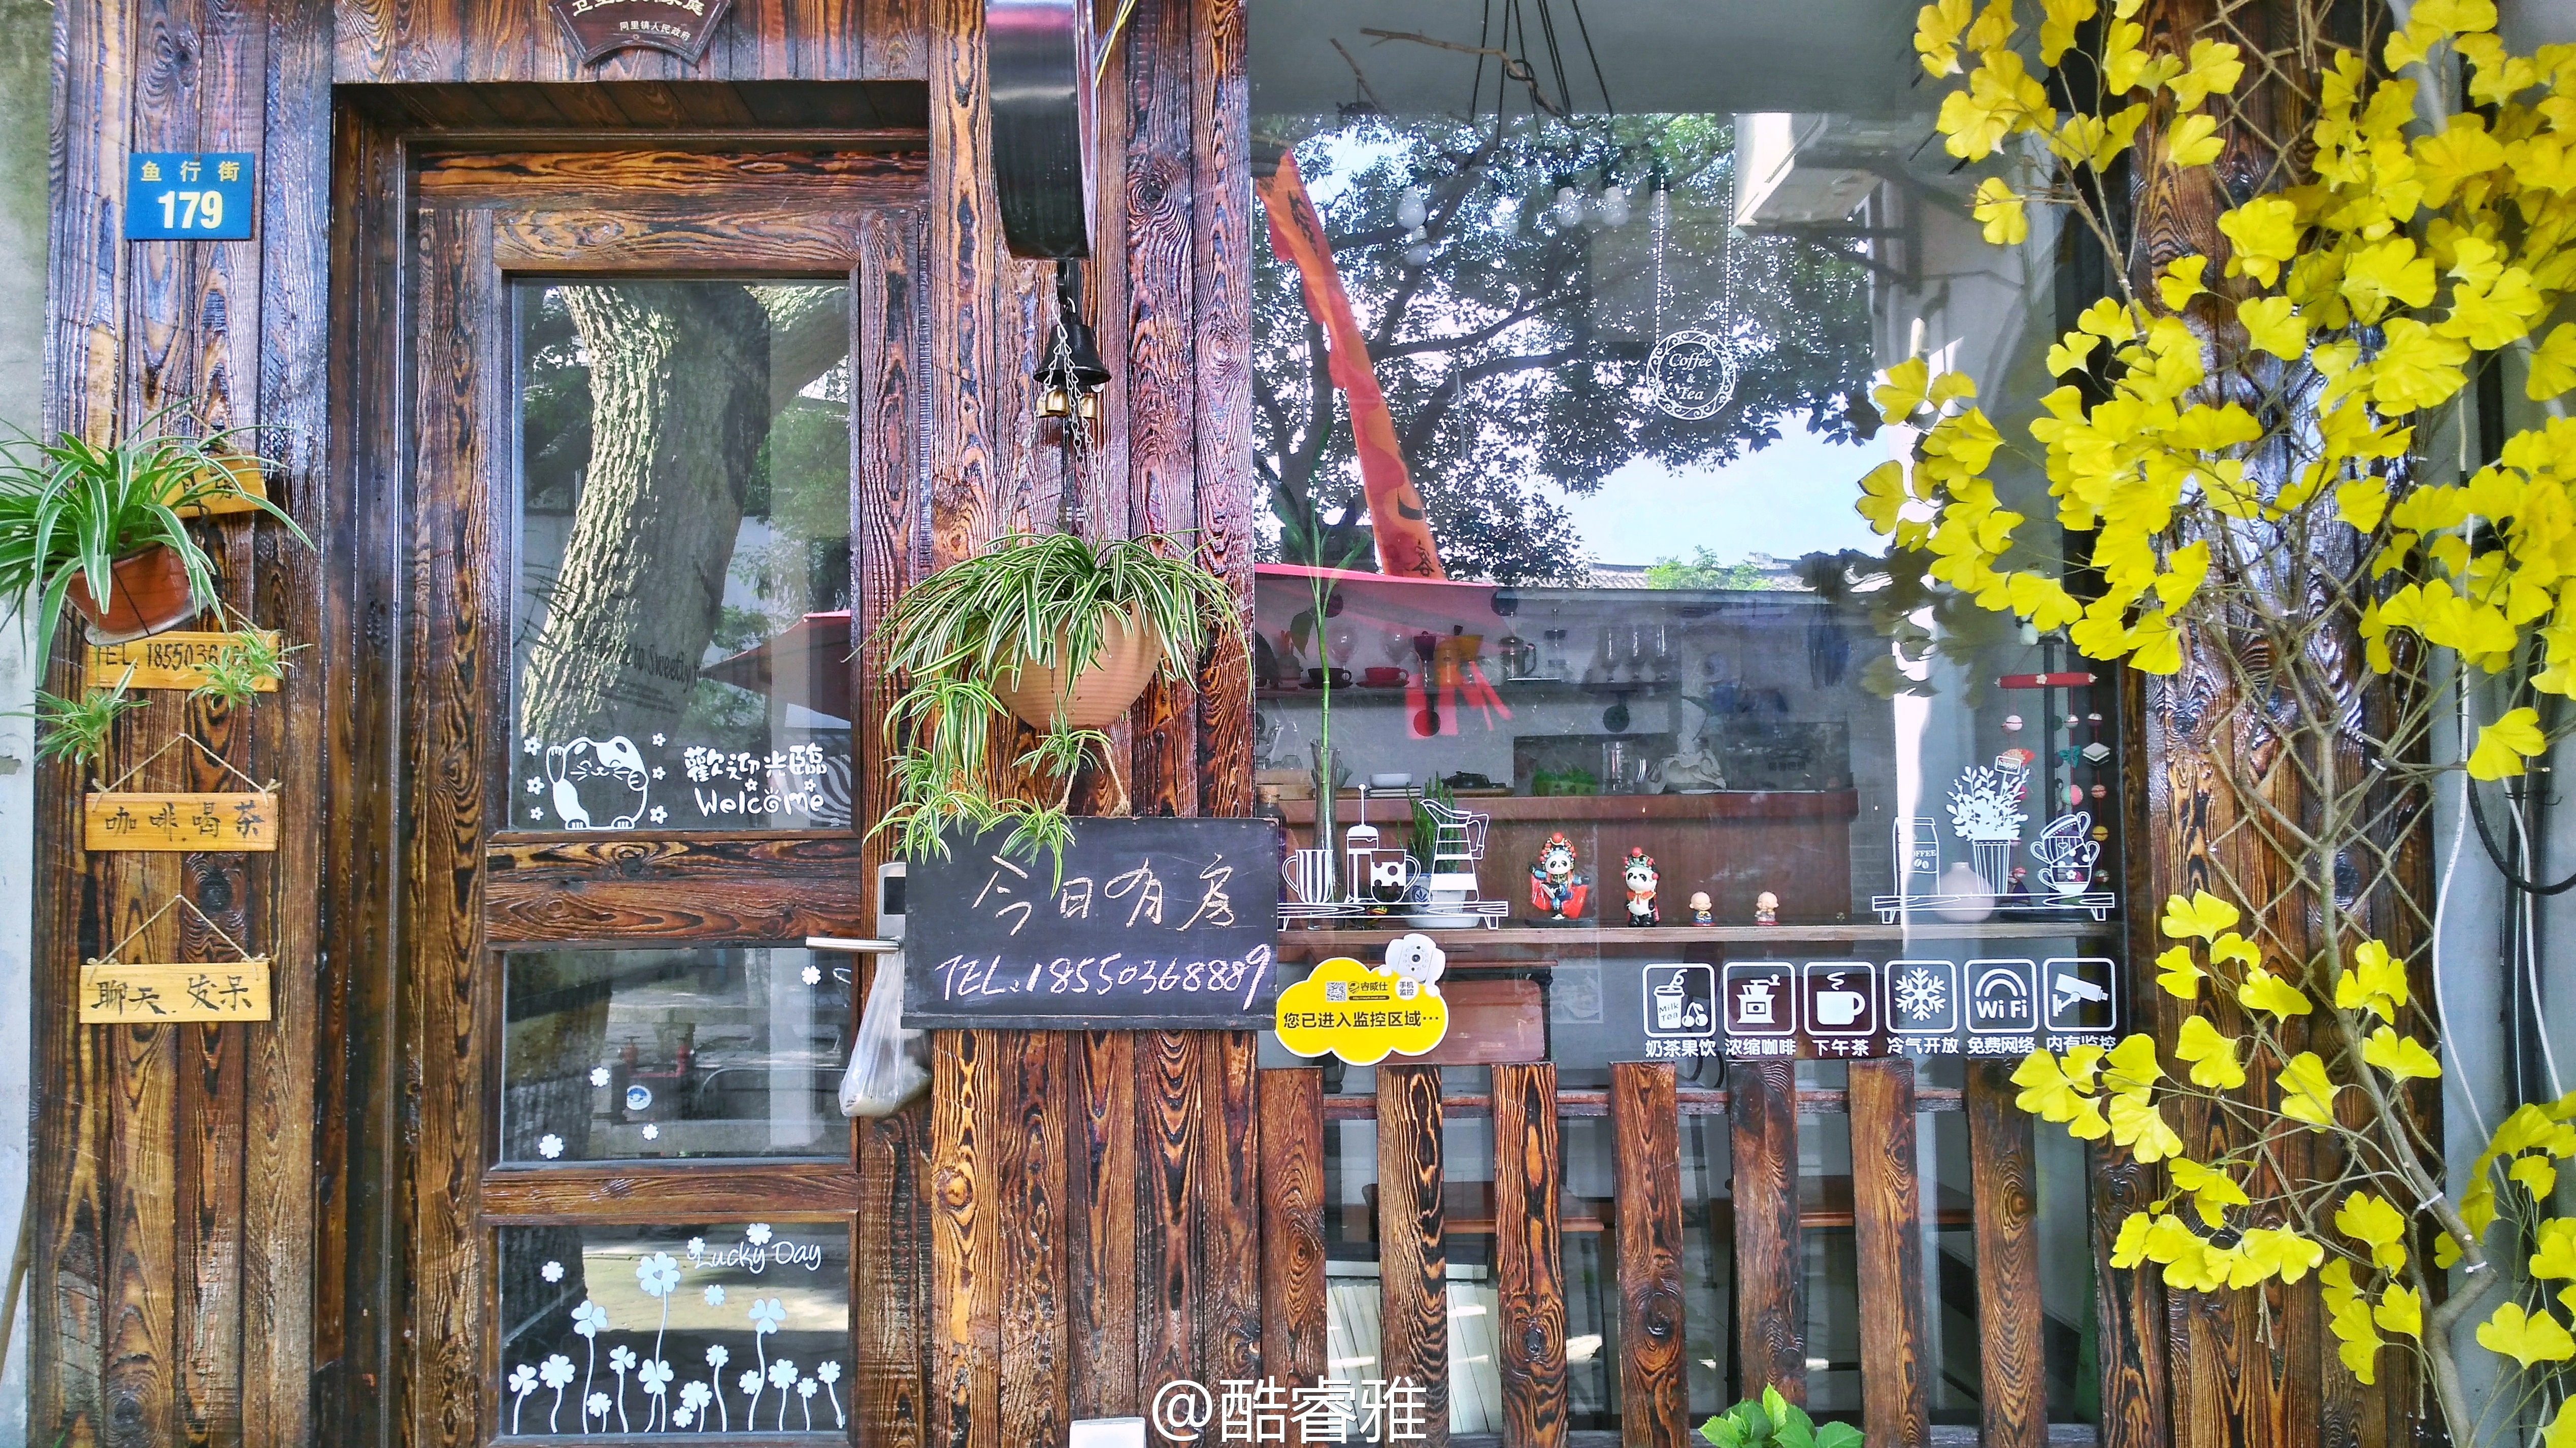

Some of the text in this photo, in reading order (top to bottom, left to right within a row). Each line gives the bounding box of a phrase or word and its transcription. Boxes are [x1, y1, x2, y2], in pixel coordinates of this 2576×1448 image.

[619, 20, 691, 41] 同里镇人民政府
[141, 160, 240, 182] 鱼行街
[158, 190, 222, 229] 179
[1669, 352, 1713, 370] Coffee
[1686, 373, 1696, 384] &
[1679, 386, 1704, 400] Tea
[684, 743, 827, 782] 歡迎光臨
[1998, 760, 2019, 770] happy
[695, 787, 824, 816] Welcome
[105, 800, 265, 841] 咖啡喝茶
[971, 853, 1237, 936] 今日有房
[1361, 981, 1388, 992] 睿威仕
[1659, 1002, 1678, 1013] Milk
[1661, 1012, 1678, 1022] Tea
[1645, 1039, 1716, 1058] 奶茶果饮
[1725, 1038, 1796, 1056] 浓缩咖啡
[1812, 1039, 1869, 1056] 下午茶
[1887, 1037, 1959, 1055] 冷气开放
[1967, 1036, 2035, 1055] 免费网络
[687, 1240, 822, 1273] Lucky Day
